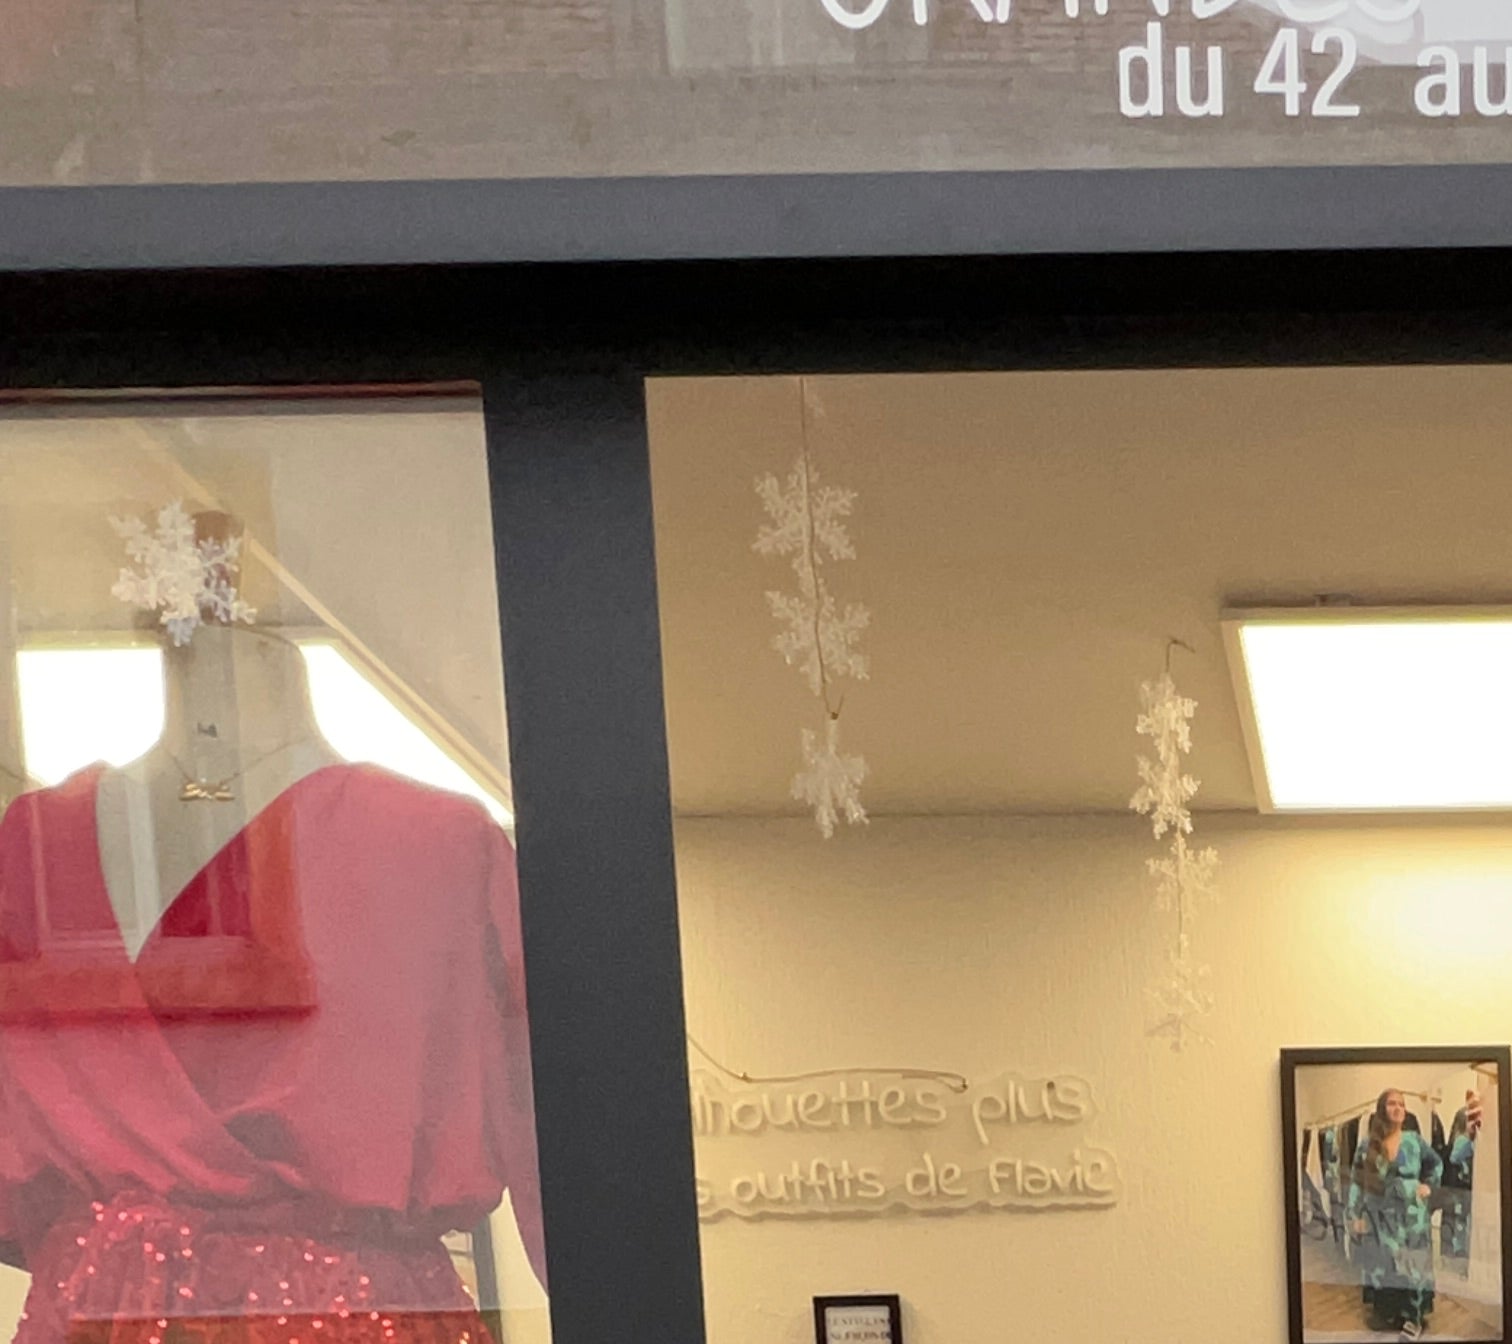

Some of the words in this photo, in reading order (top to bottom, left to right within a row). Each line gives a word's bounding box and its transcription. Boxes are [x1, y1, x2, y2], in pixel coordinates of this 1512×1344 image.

[1118, 22, 1223, 117] du
[1253, 27, 1361, 117] 42
[695, 1079, 947, 1132] lhouettes
[972, 1078, 1089, 1145] plus
[730, 1158, 886, 1203] outfits
[905, 1151, 968, 1197] de
[988, 1148, 1114, 1195] Flavie
